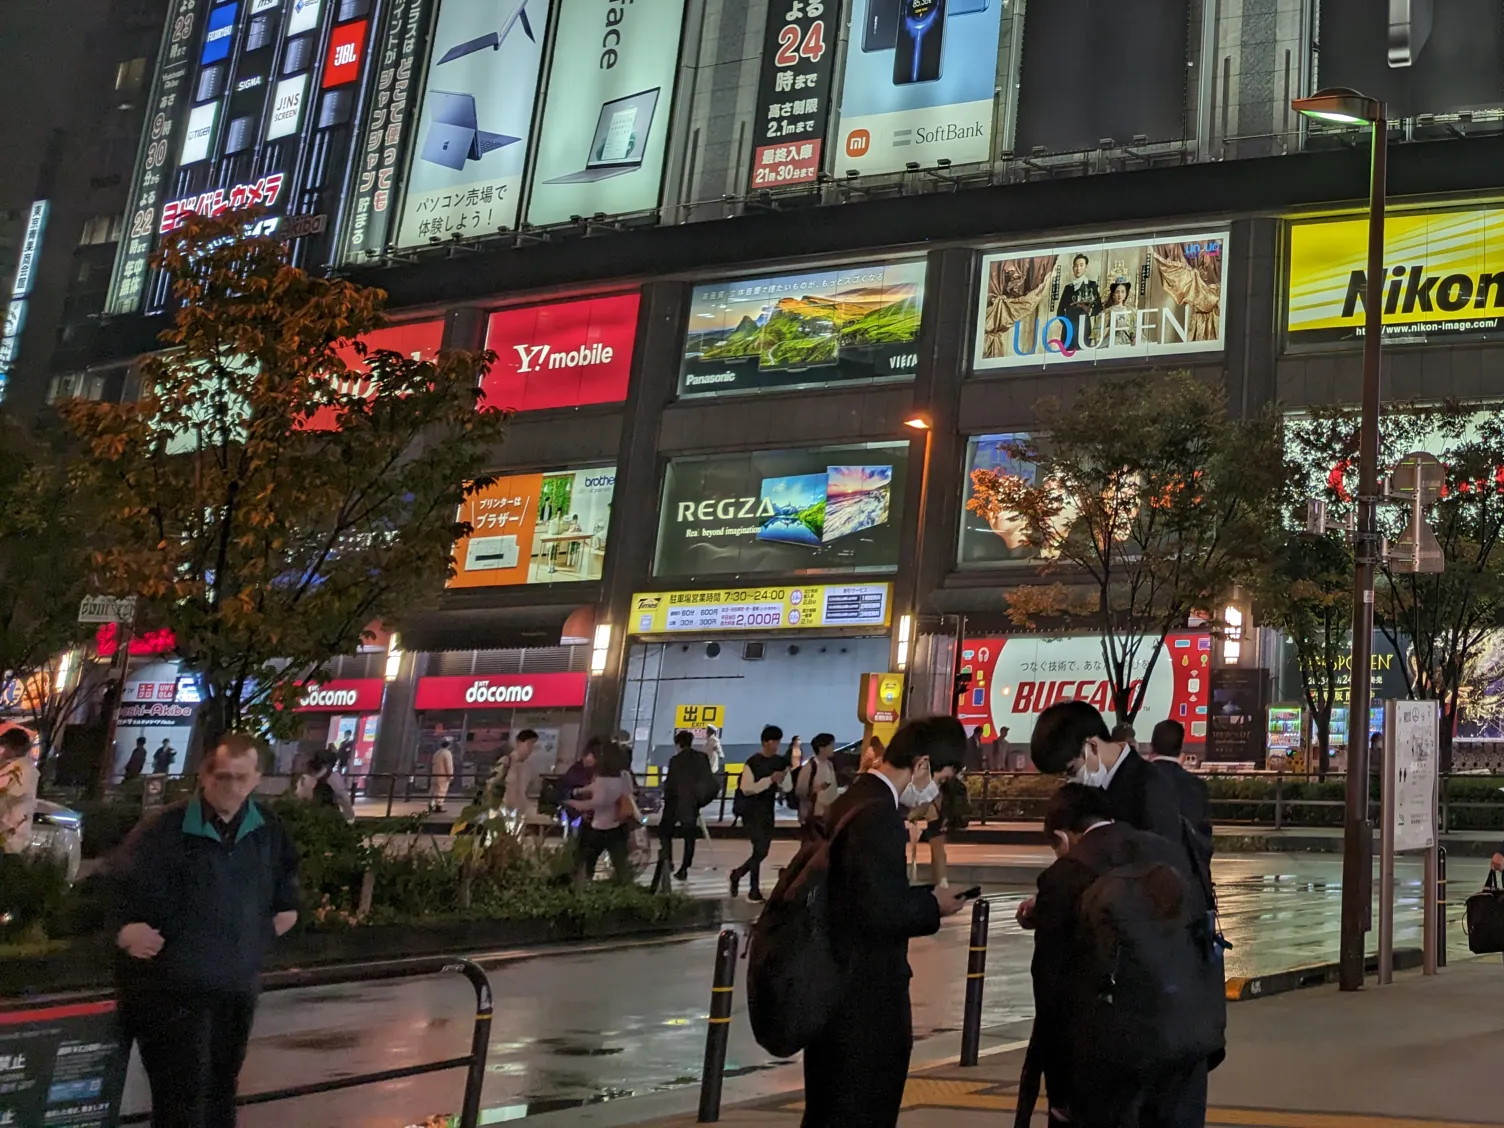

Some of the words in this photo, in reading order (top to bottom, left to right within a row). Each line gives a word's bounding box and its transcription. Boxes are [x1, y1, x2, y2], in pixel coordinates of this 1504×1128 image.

[774, 20, 826, 68] 24
[238, 76, 261, 92] SIGMA
[774, 71, 818, 93] 時まで
[766, 97, 819, 120] 高さ制限
[765, 119, 815, 139] 2.1mまで
[914, 120, 984, 146] SoftBank
[761, 142, 814, 166] 最終入庫
[755, 164, 815, 185] 21時30分まで
[416, 183, 509, 212] パソコン売場で
[131, 207, 155, 239] 22
[1012, 304, 1189, 358] UQUEEN
[512, 341, 614, 373] Y!mobile
[685, 370, 736, 386] Panasonic
[479, 496, 522, 510] プリンターは
[676, 496, 775, 522] REGZA
[476, 511, 520, 530] ブラザー
[638, 598, 661, 611] Times
[668, 592, 722, 604] 駐車場営業時間
[736, 612, 780, 627] 2,000円
[464, 680, 534, 704] docomo
[682, 706, 717, 722] 出口
